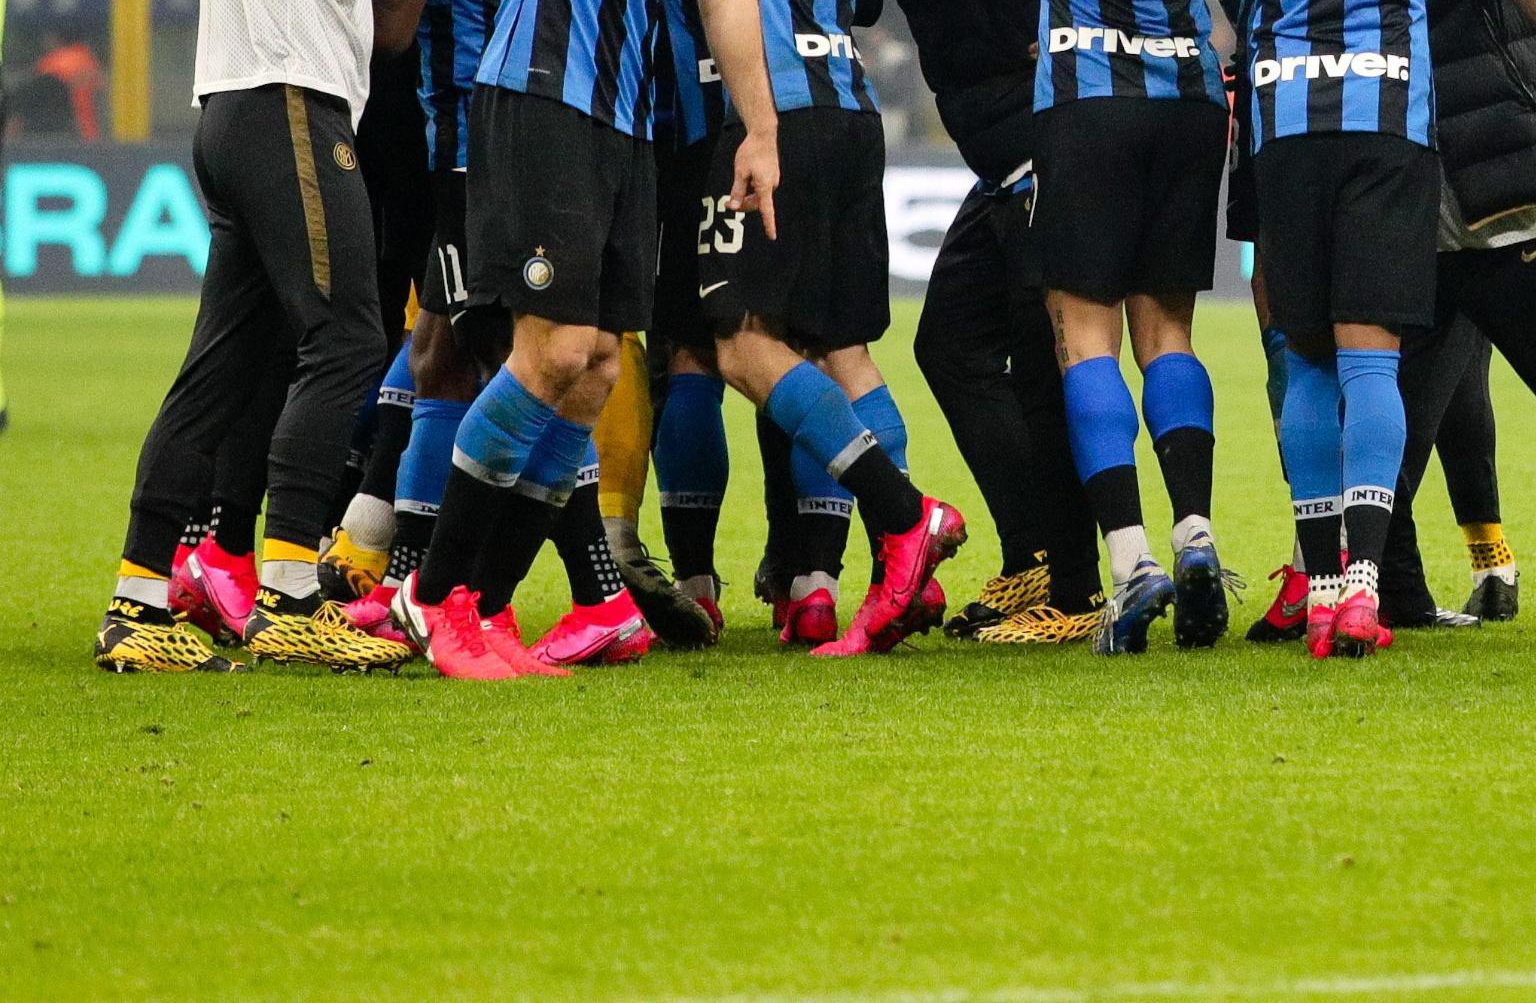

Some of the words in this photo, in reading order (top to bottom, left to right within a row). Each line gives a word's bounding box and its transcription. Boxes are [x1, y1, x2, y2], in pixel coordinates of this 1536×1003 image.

[0, 162, 211, 278] RA
[697, 195, 746, 255] 23
[1351, 489, 1393, 507] INTER
